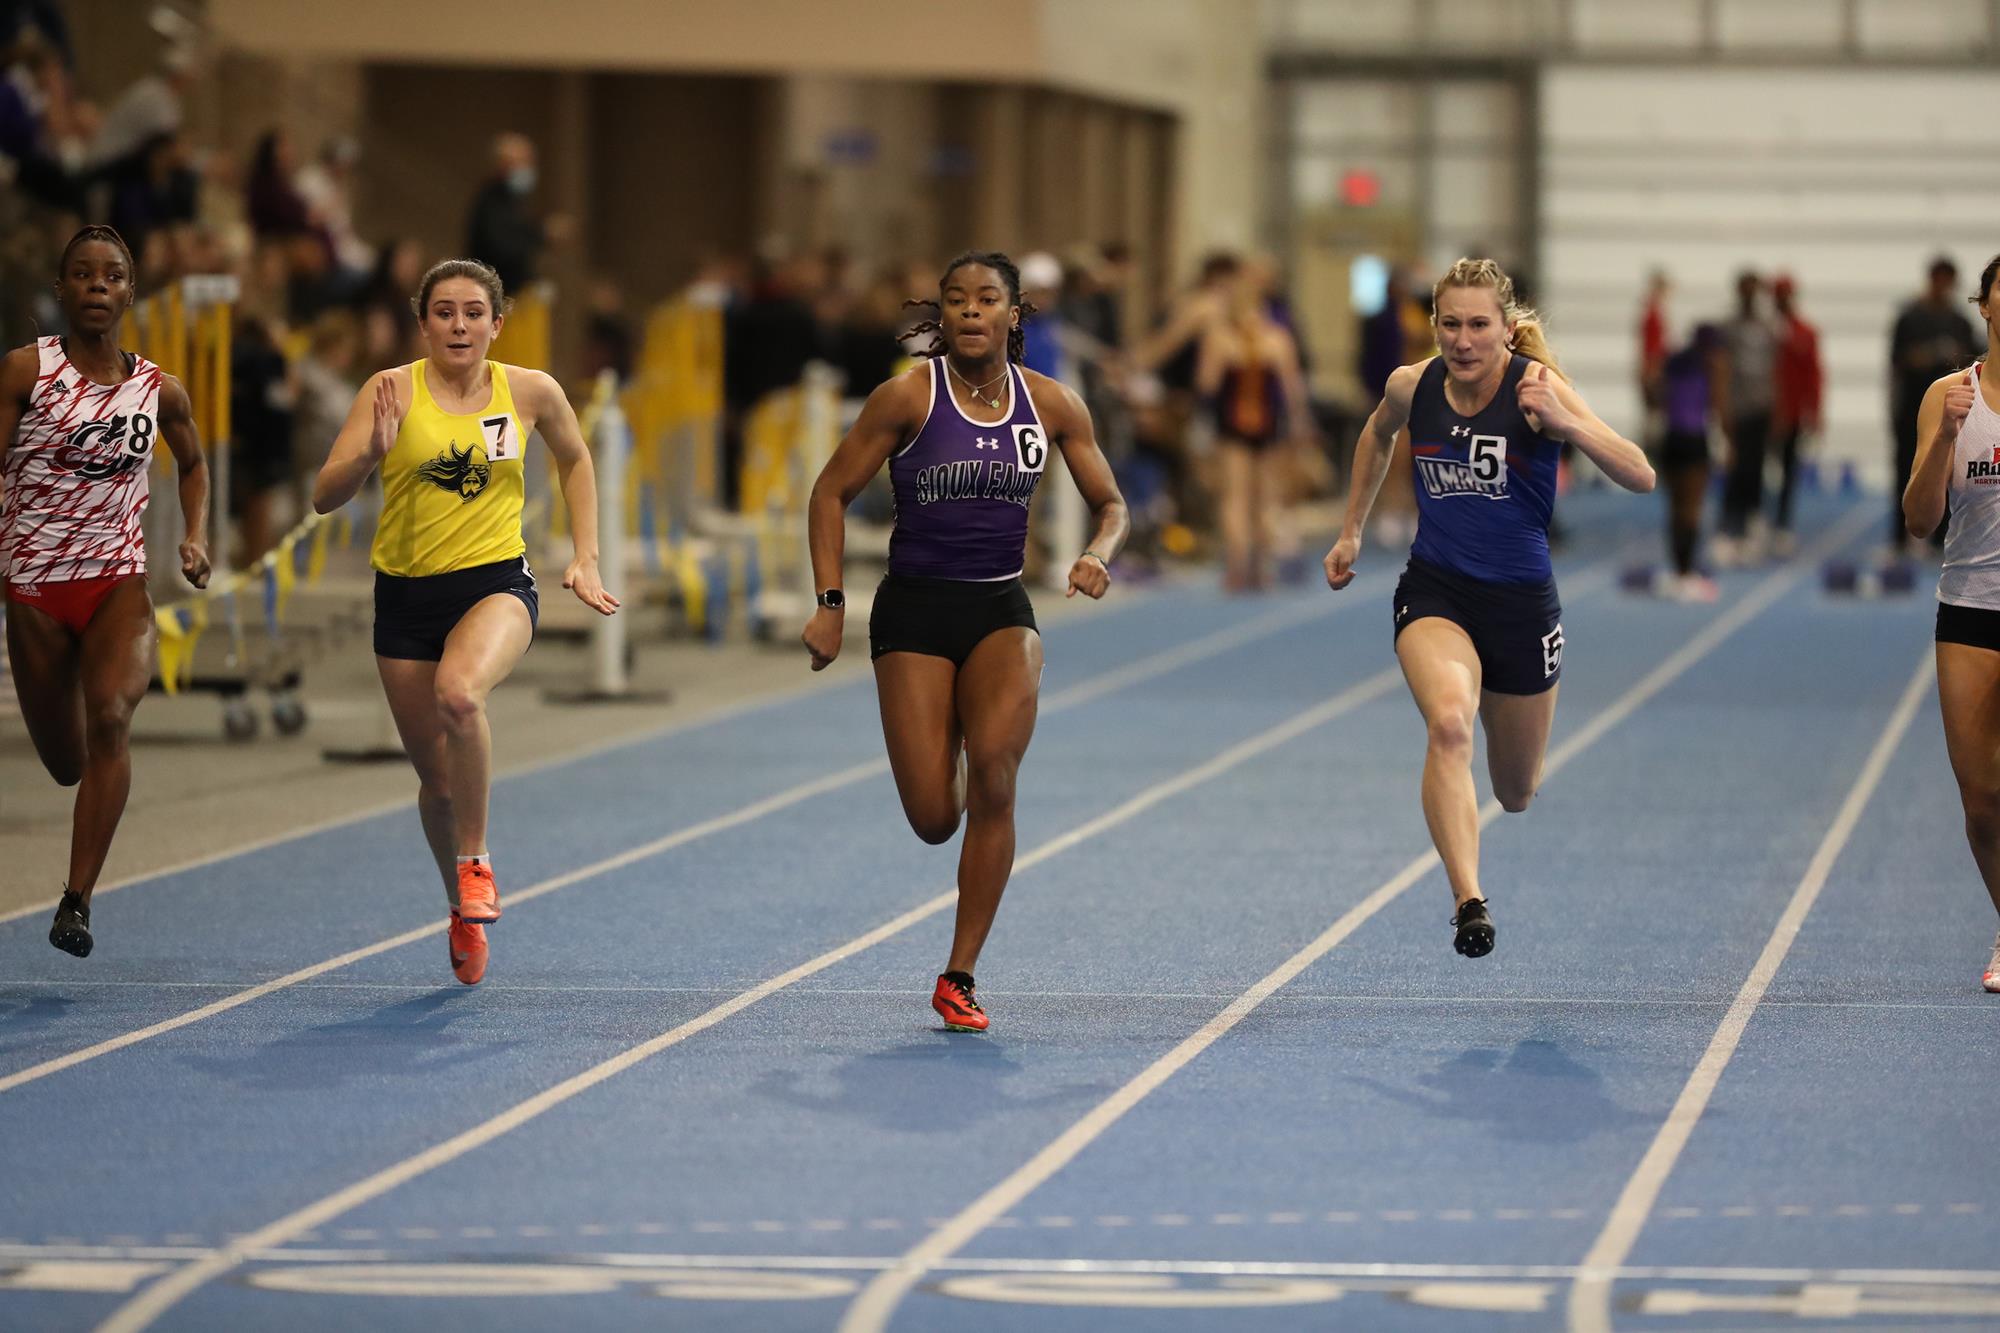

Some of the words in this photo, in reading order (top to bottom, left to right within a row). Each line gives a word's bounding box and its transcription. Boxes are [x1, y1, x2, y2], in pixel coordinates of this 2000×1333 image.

[129, 413, 153, 455] 8
[483, 416, 508, 457] 7
[1018, 427, 1043, 470] 6
[1473, 439, 1499, 481] 5
[1966, 460, 2000, 480] RAI
[917, 460, 982, 506] SIOUX
[1545, 629, 1563, 672] 5
